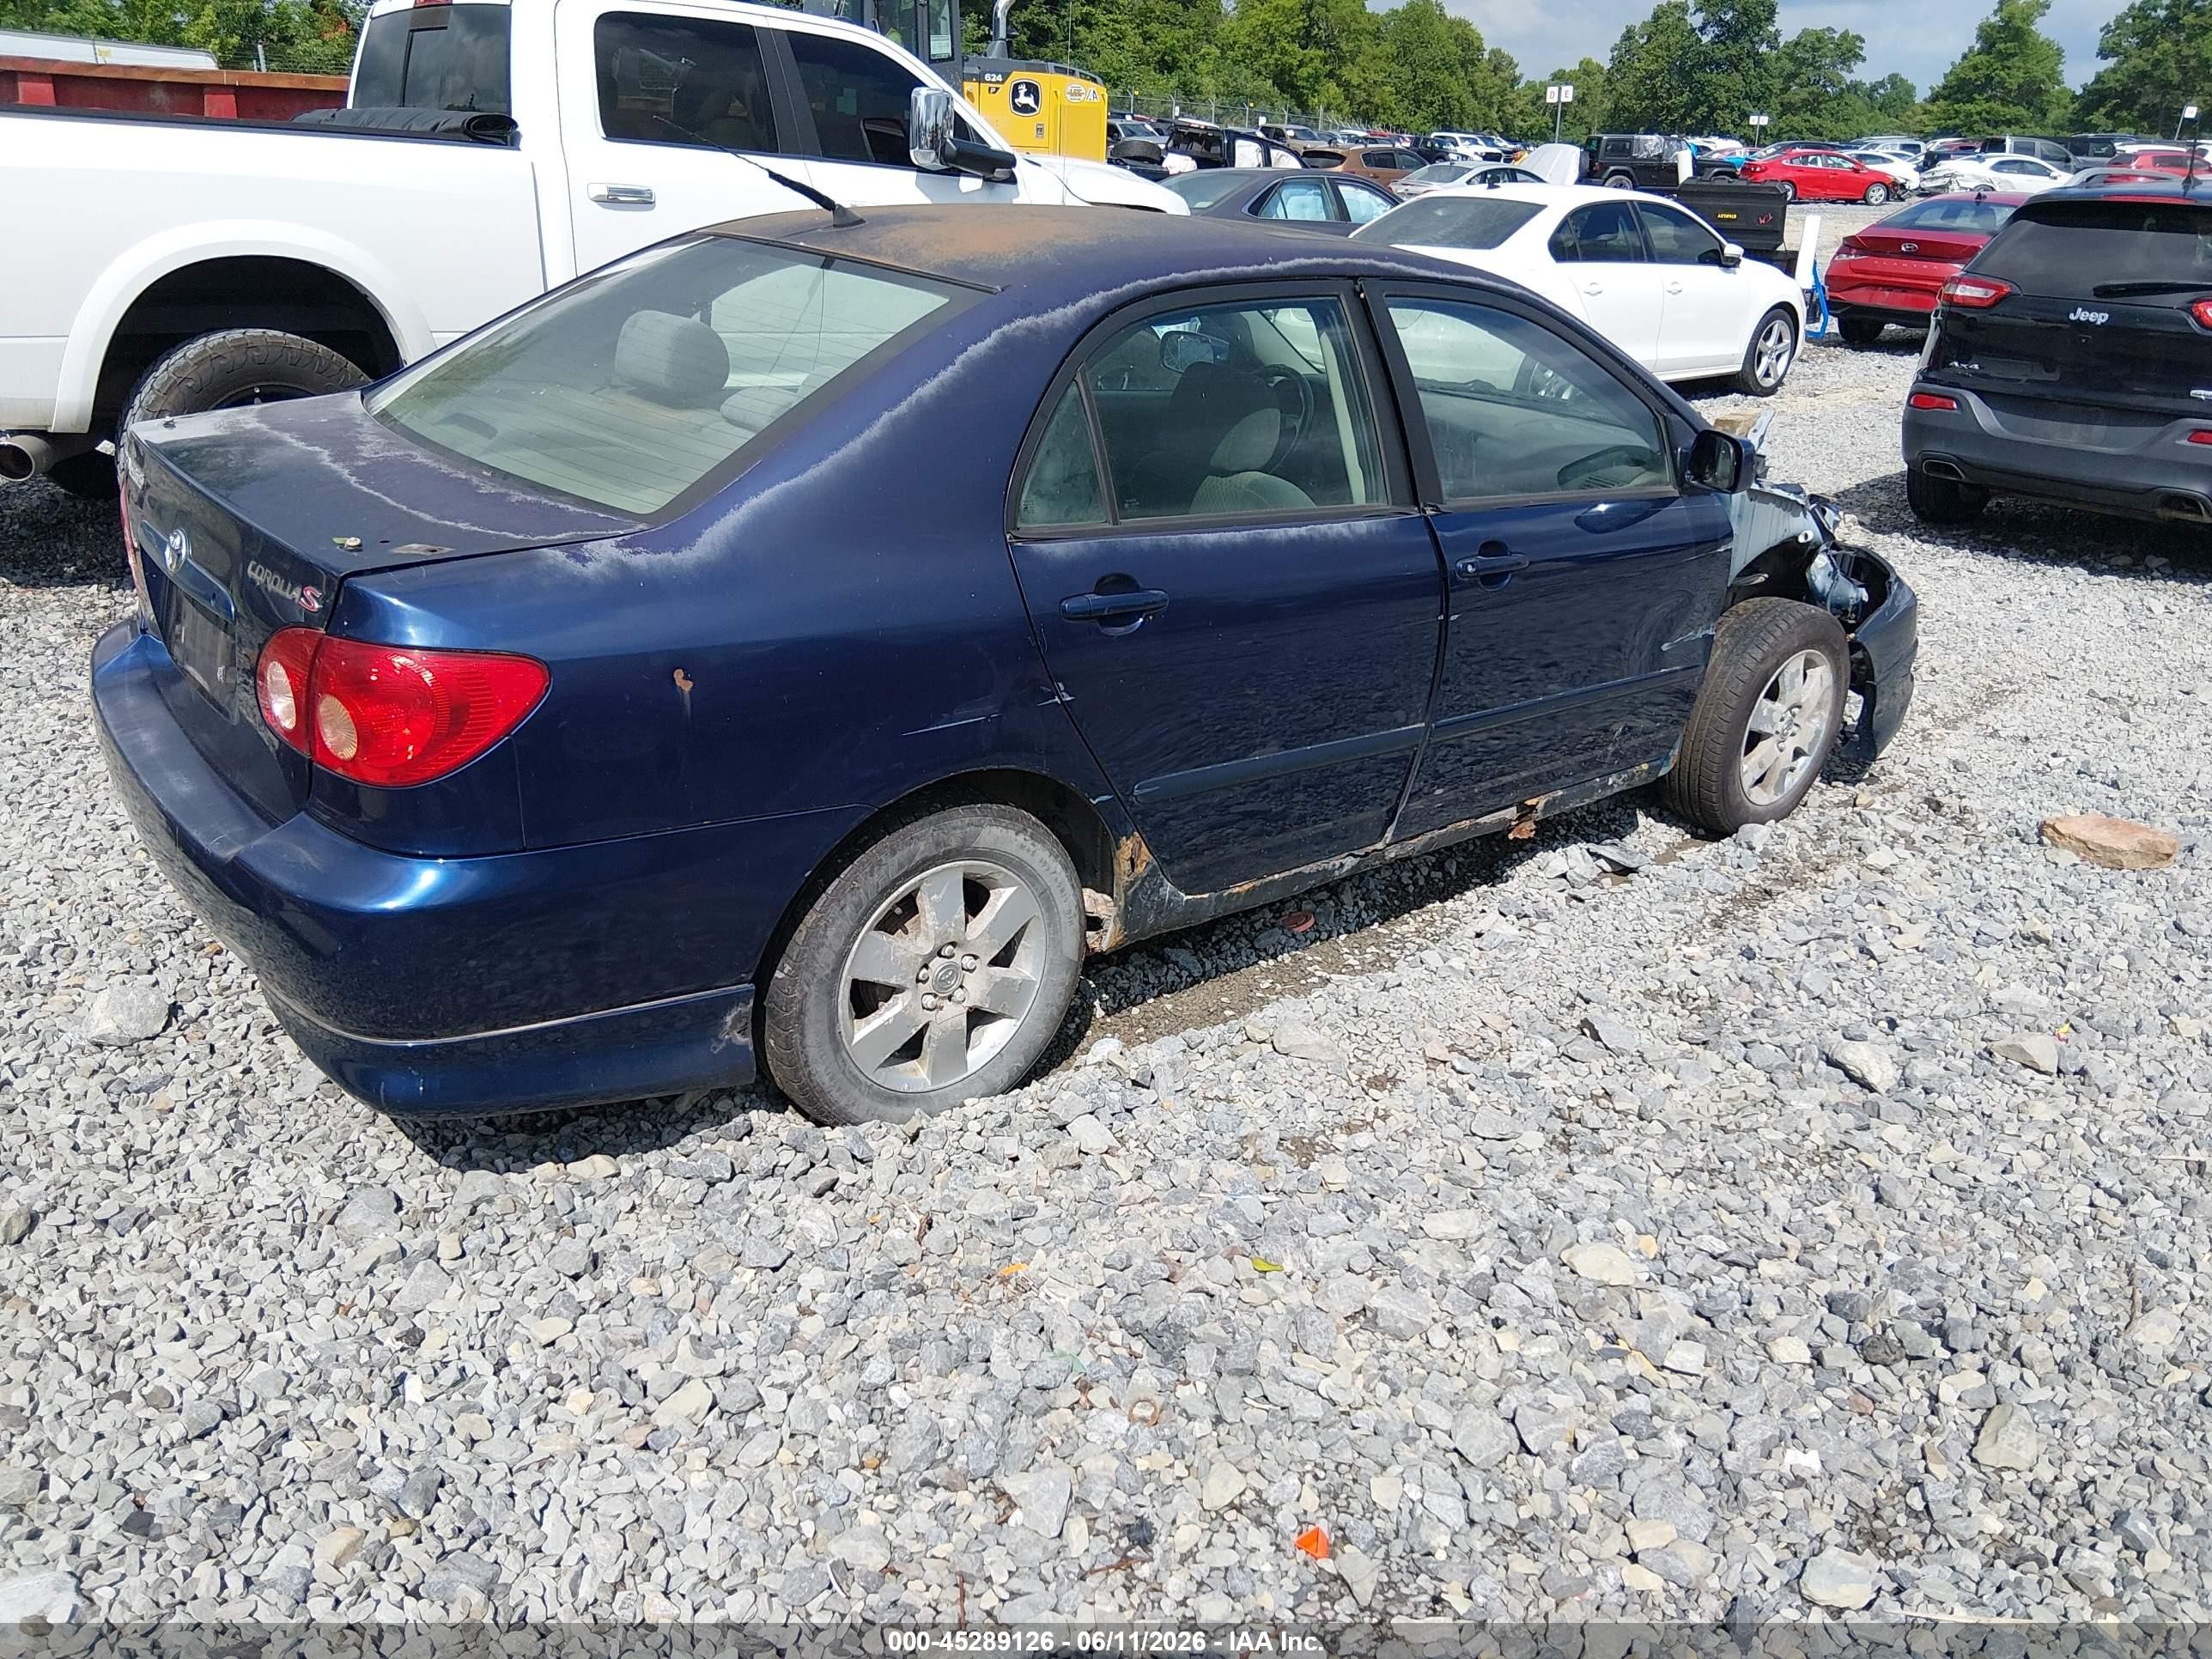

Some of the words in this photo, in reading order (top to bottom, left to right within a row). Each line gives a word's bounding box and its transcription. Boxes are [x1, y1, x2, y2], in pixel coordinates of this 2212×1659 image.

[984, 74, 1003, 82] 624
[1549, 90, 1555, 100] D
[1564, 89, 1570, 99] E
[2069, 307, 2110, 325] Jeep
[246, 560, 302, 604] COROLLA
[298, 586, 323, 612] S
